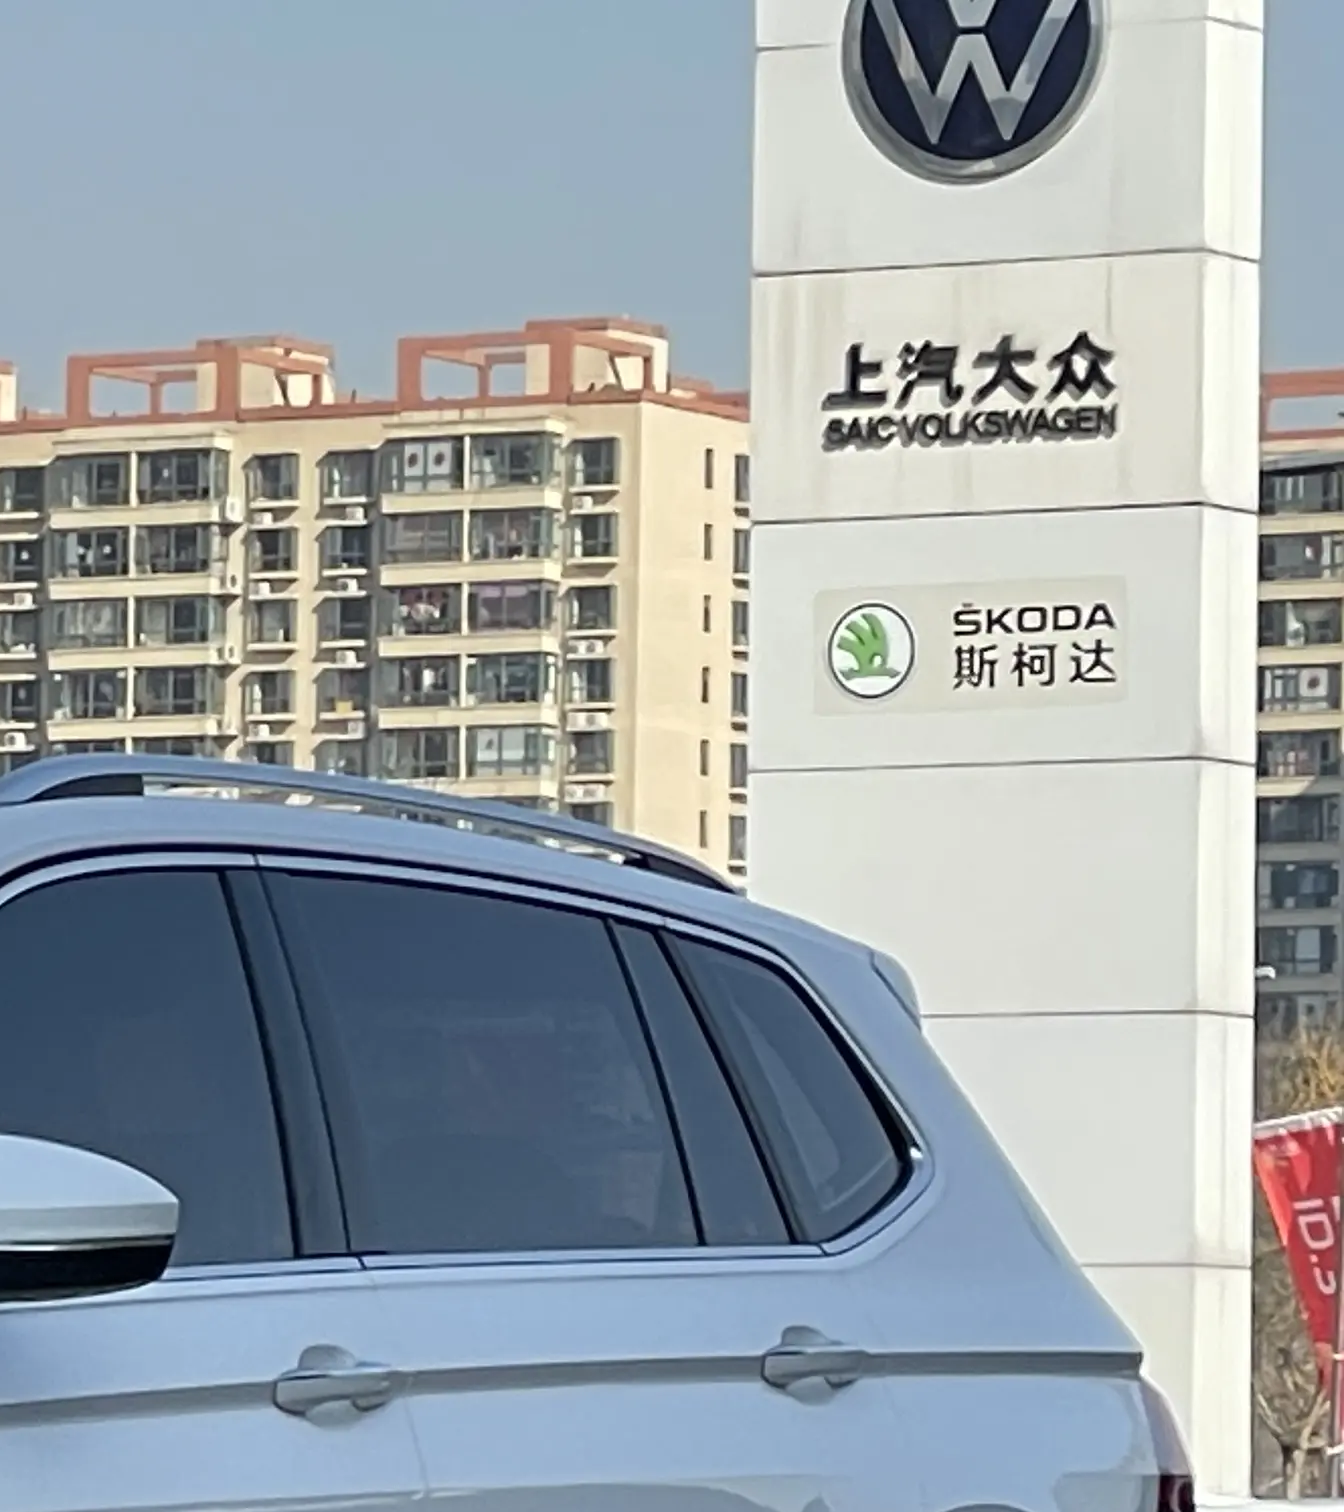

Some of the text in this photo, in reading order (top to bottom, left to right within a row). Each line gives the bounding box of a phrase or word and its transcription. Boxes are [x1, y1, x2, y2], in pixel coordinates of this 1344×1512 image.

[869, 0, 1080, 145] W
[821, 331, 1118, 411] 上汽大众
[953, 602, 1117, 637] ŠKODA
[953, 639, 1117, 690] 斯柯达
